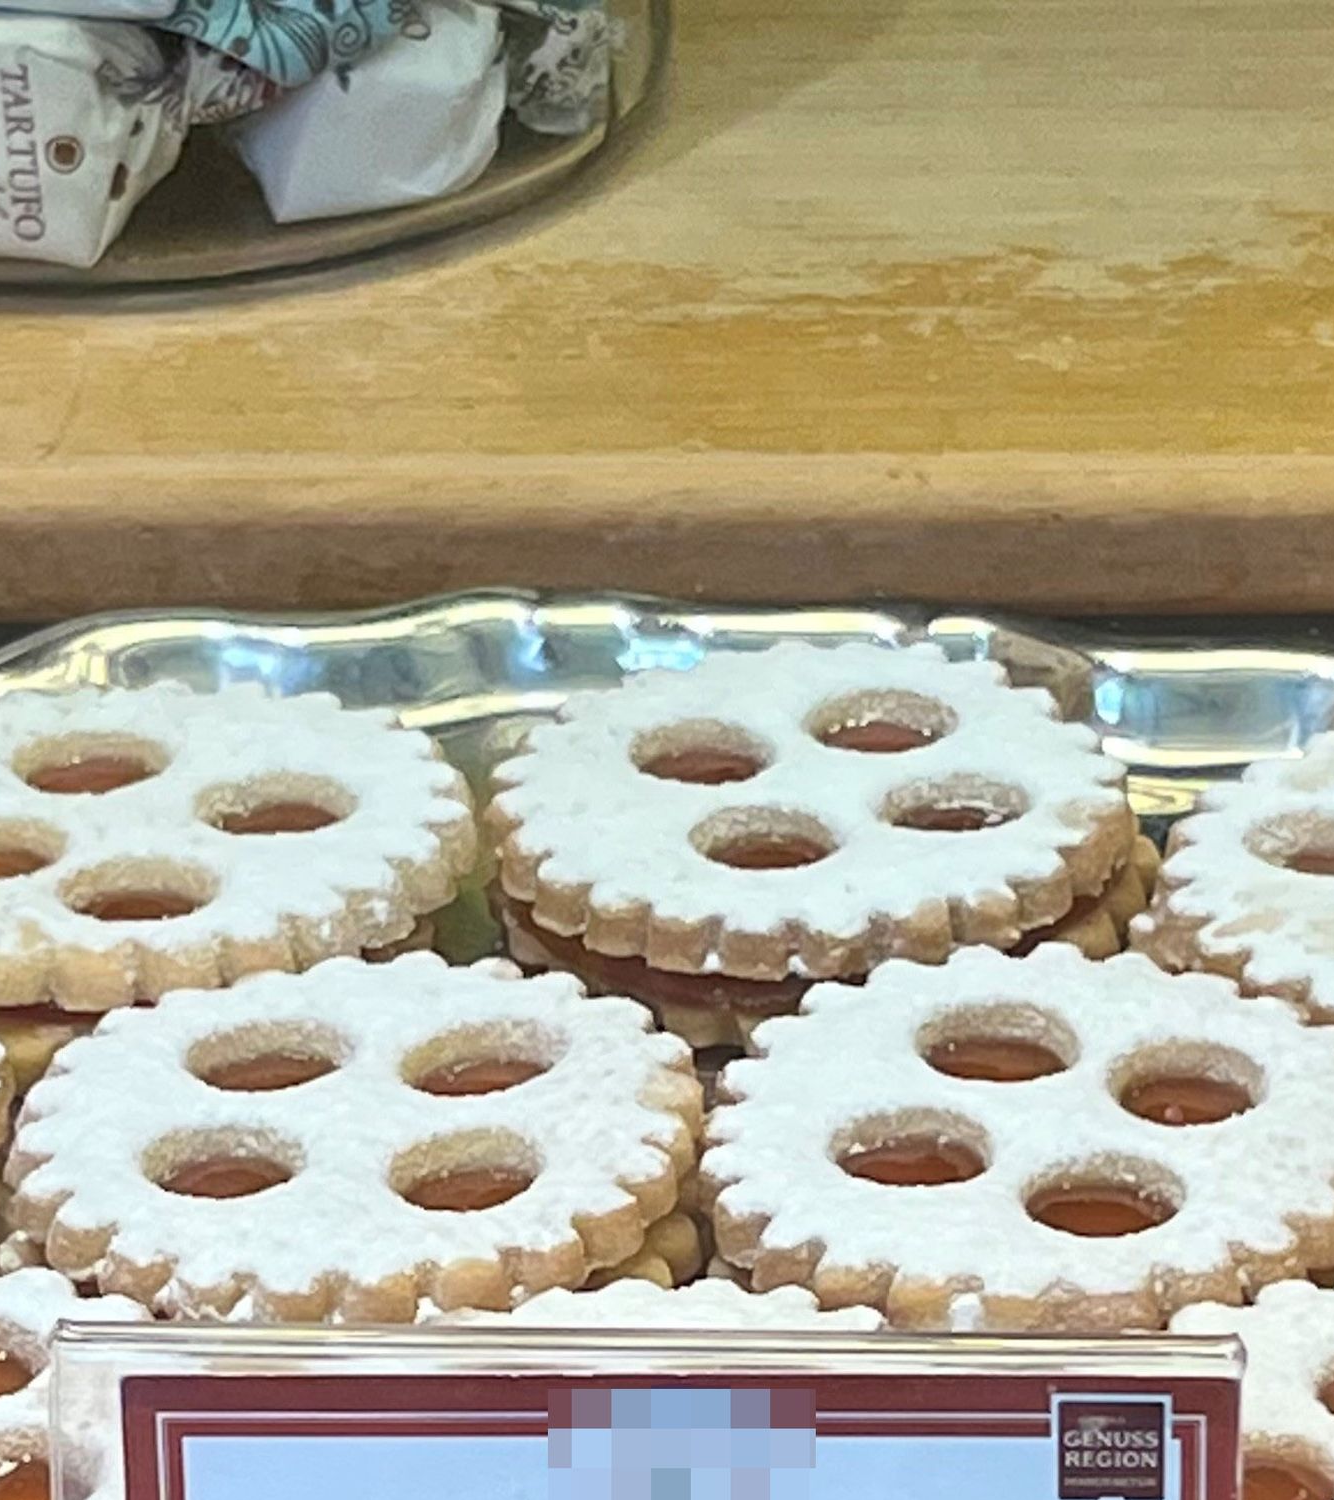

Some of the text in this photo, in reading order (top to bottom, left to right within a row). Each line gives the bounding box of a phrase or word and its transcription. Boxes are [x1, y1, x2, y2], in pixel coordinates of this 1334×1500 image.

[0, 63, 46, 242] TARTUFO
[1063, 1429, 1159, 1448] GENUSS
[1064, 1450, 1158, 1468] REGION
